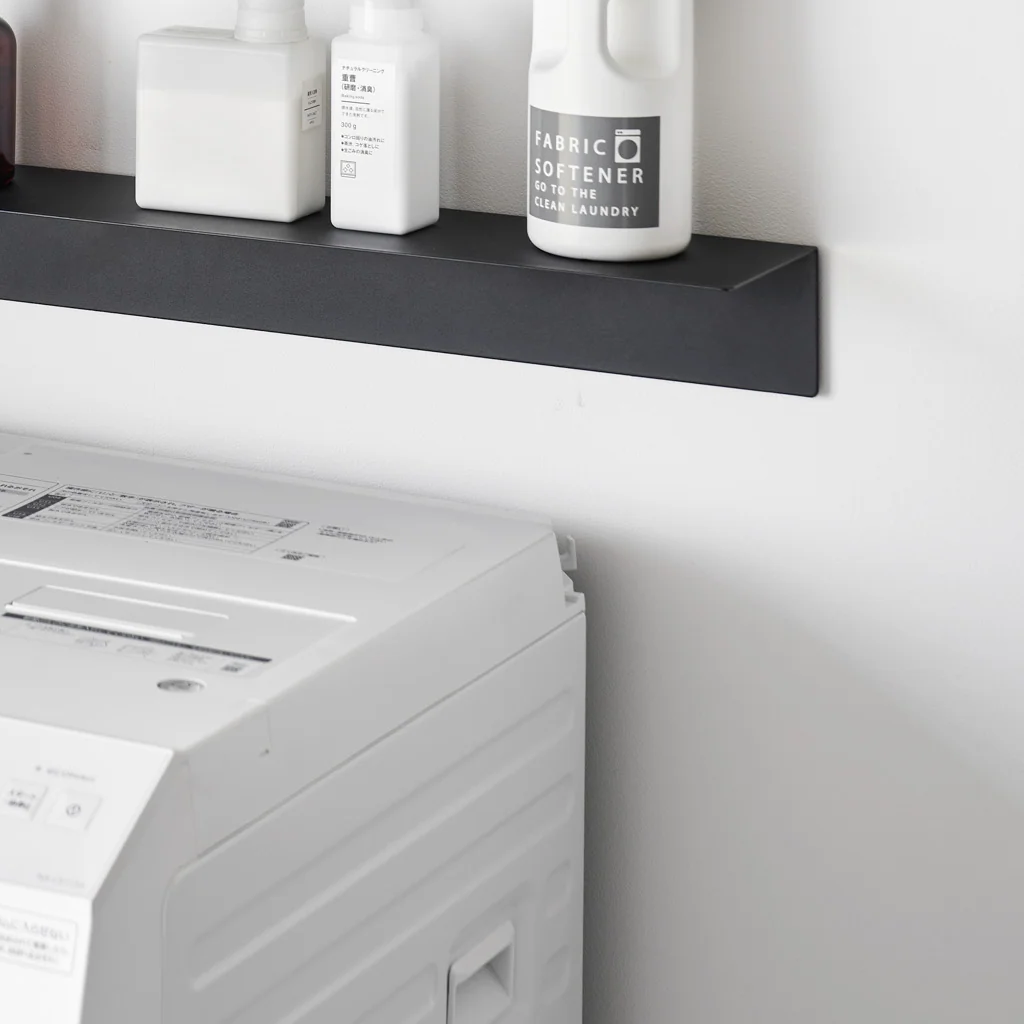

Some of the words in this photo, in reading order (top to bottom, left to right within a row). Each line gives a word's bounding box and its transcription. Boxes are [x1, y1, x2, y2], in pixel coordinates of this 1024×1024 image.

[342, 73, 356, 83] 重曹
[534, 130, 607, 155] FABRIC
[534, 158, 644, 184] SOFTENER
[534, 180, 547, 193] GO
[550, 184, 566, 196] TO
[571, 187, 597, 200] THE
[534, 196, 565, 212] CLEAN
[571, 204, 639, 217] LAUNDRY
